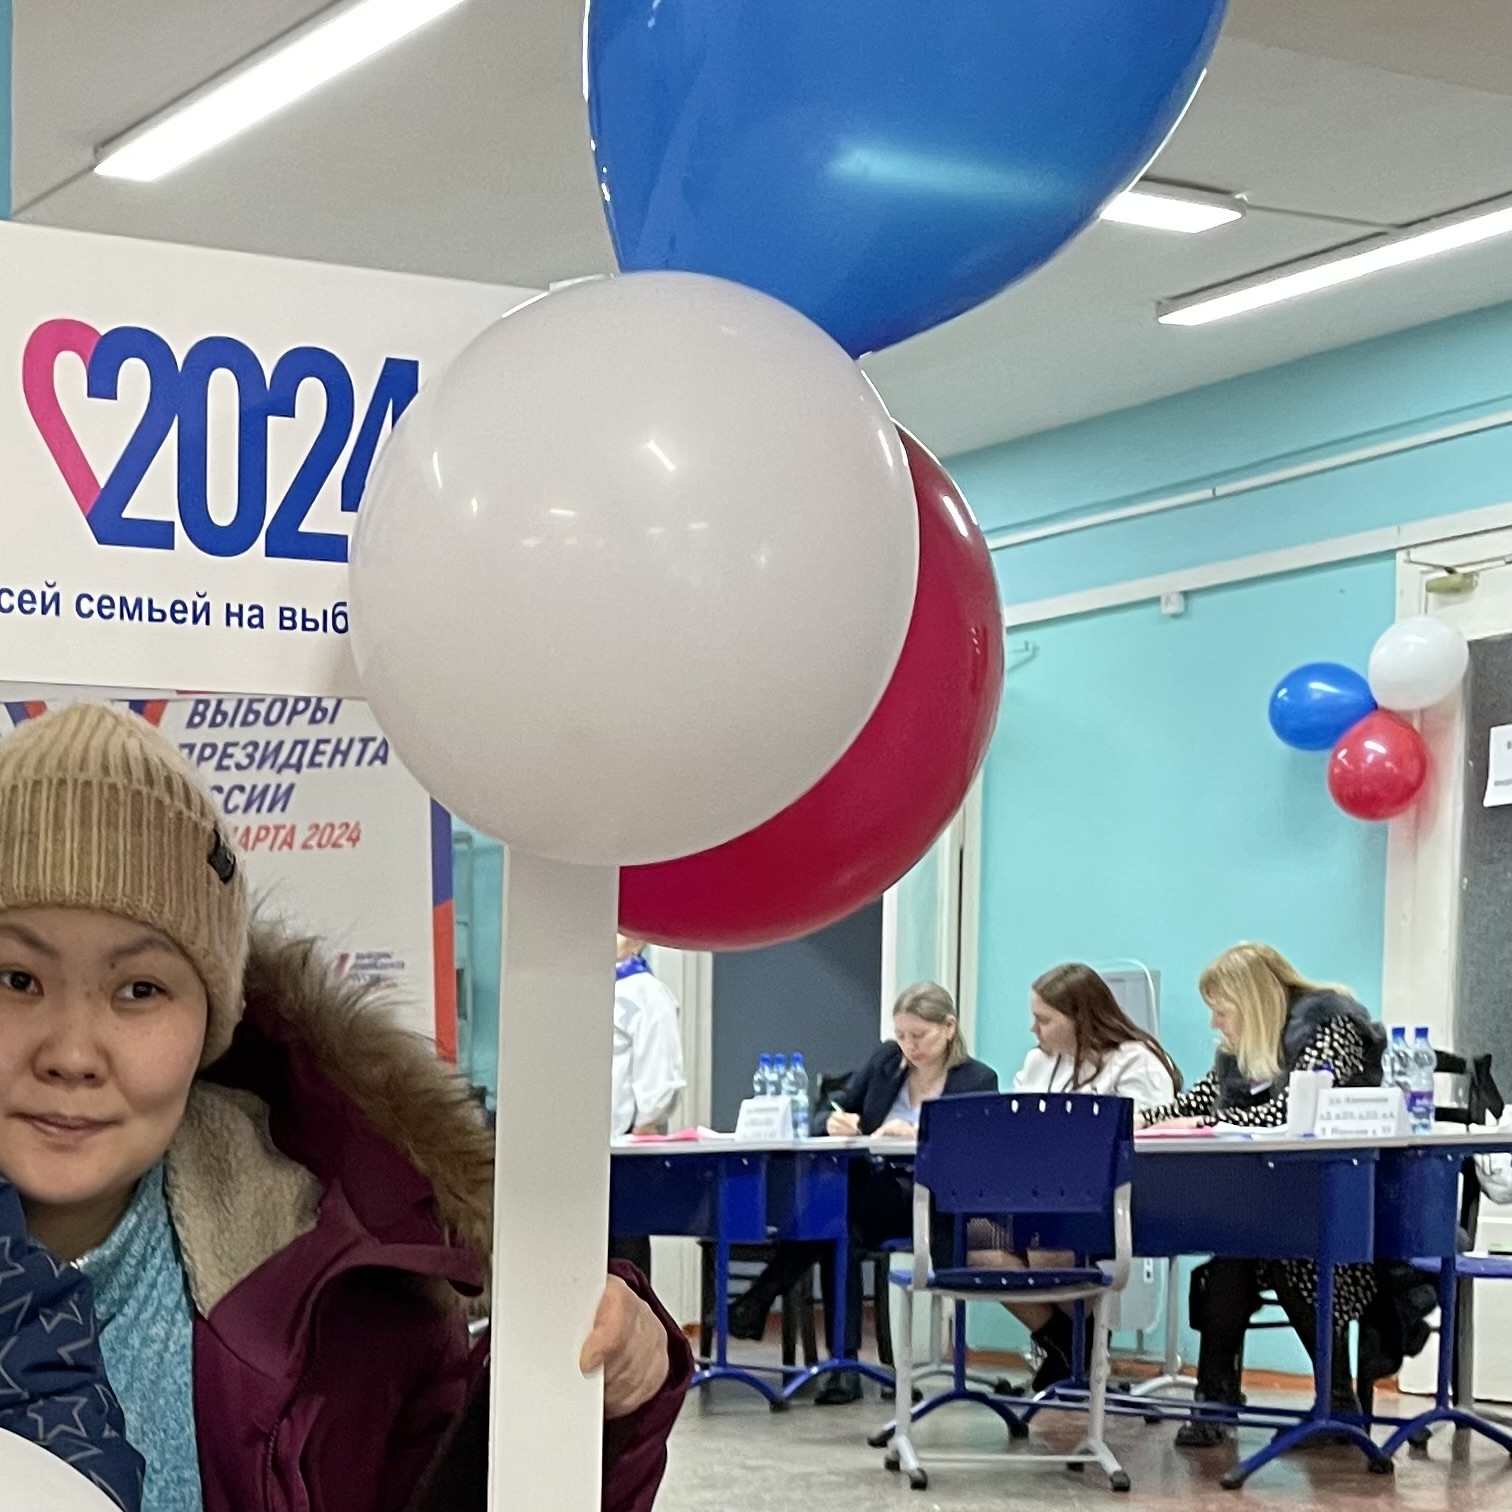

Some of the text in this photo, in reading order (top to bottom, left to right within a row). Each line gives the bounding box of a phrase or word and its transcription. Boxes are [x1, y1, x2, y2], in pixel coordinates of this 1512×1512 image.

[75, 591, 212, 627] семьей
[225, 602, 264, 630] на
[279, 600, 349, 634] выб
[185, 697, 343, 729] ВЫБОРЫ
[210, 783, 296, 814] СИИ
[235, 821, 362, 852] АРТА 2024
